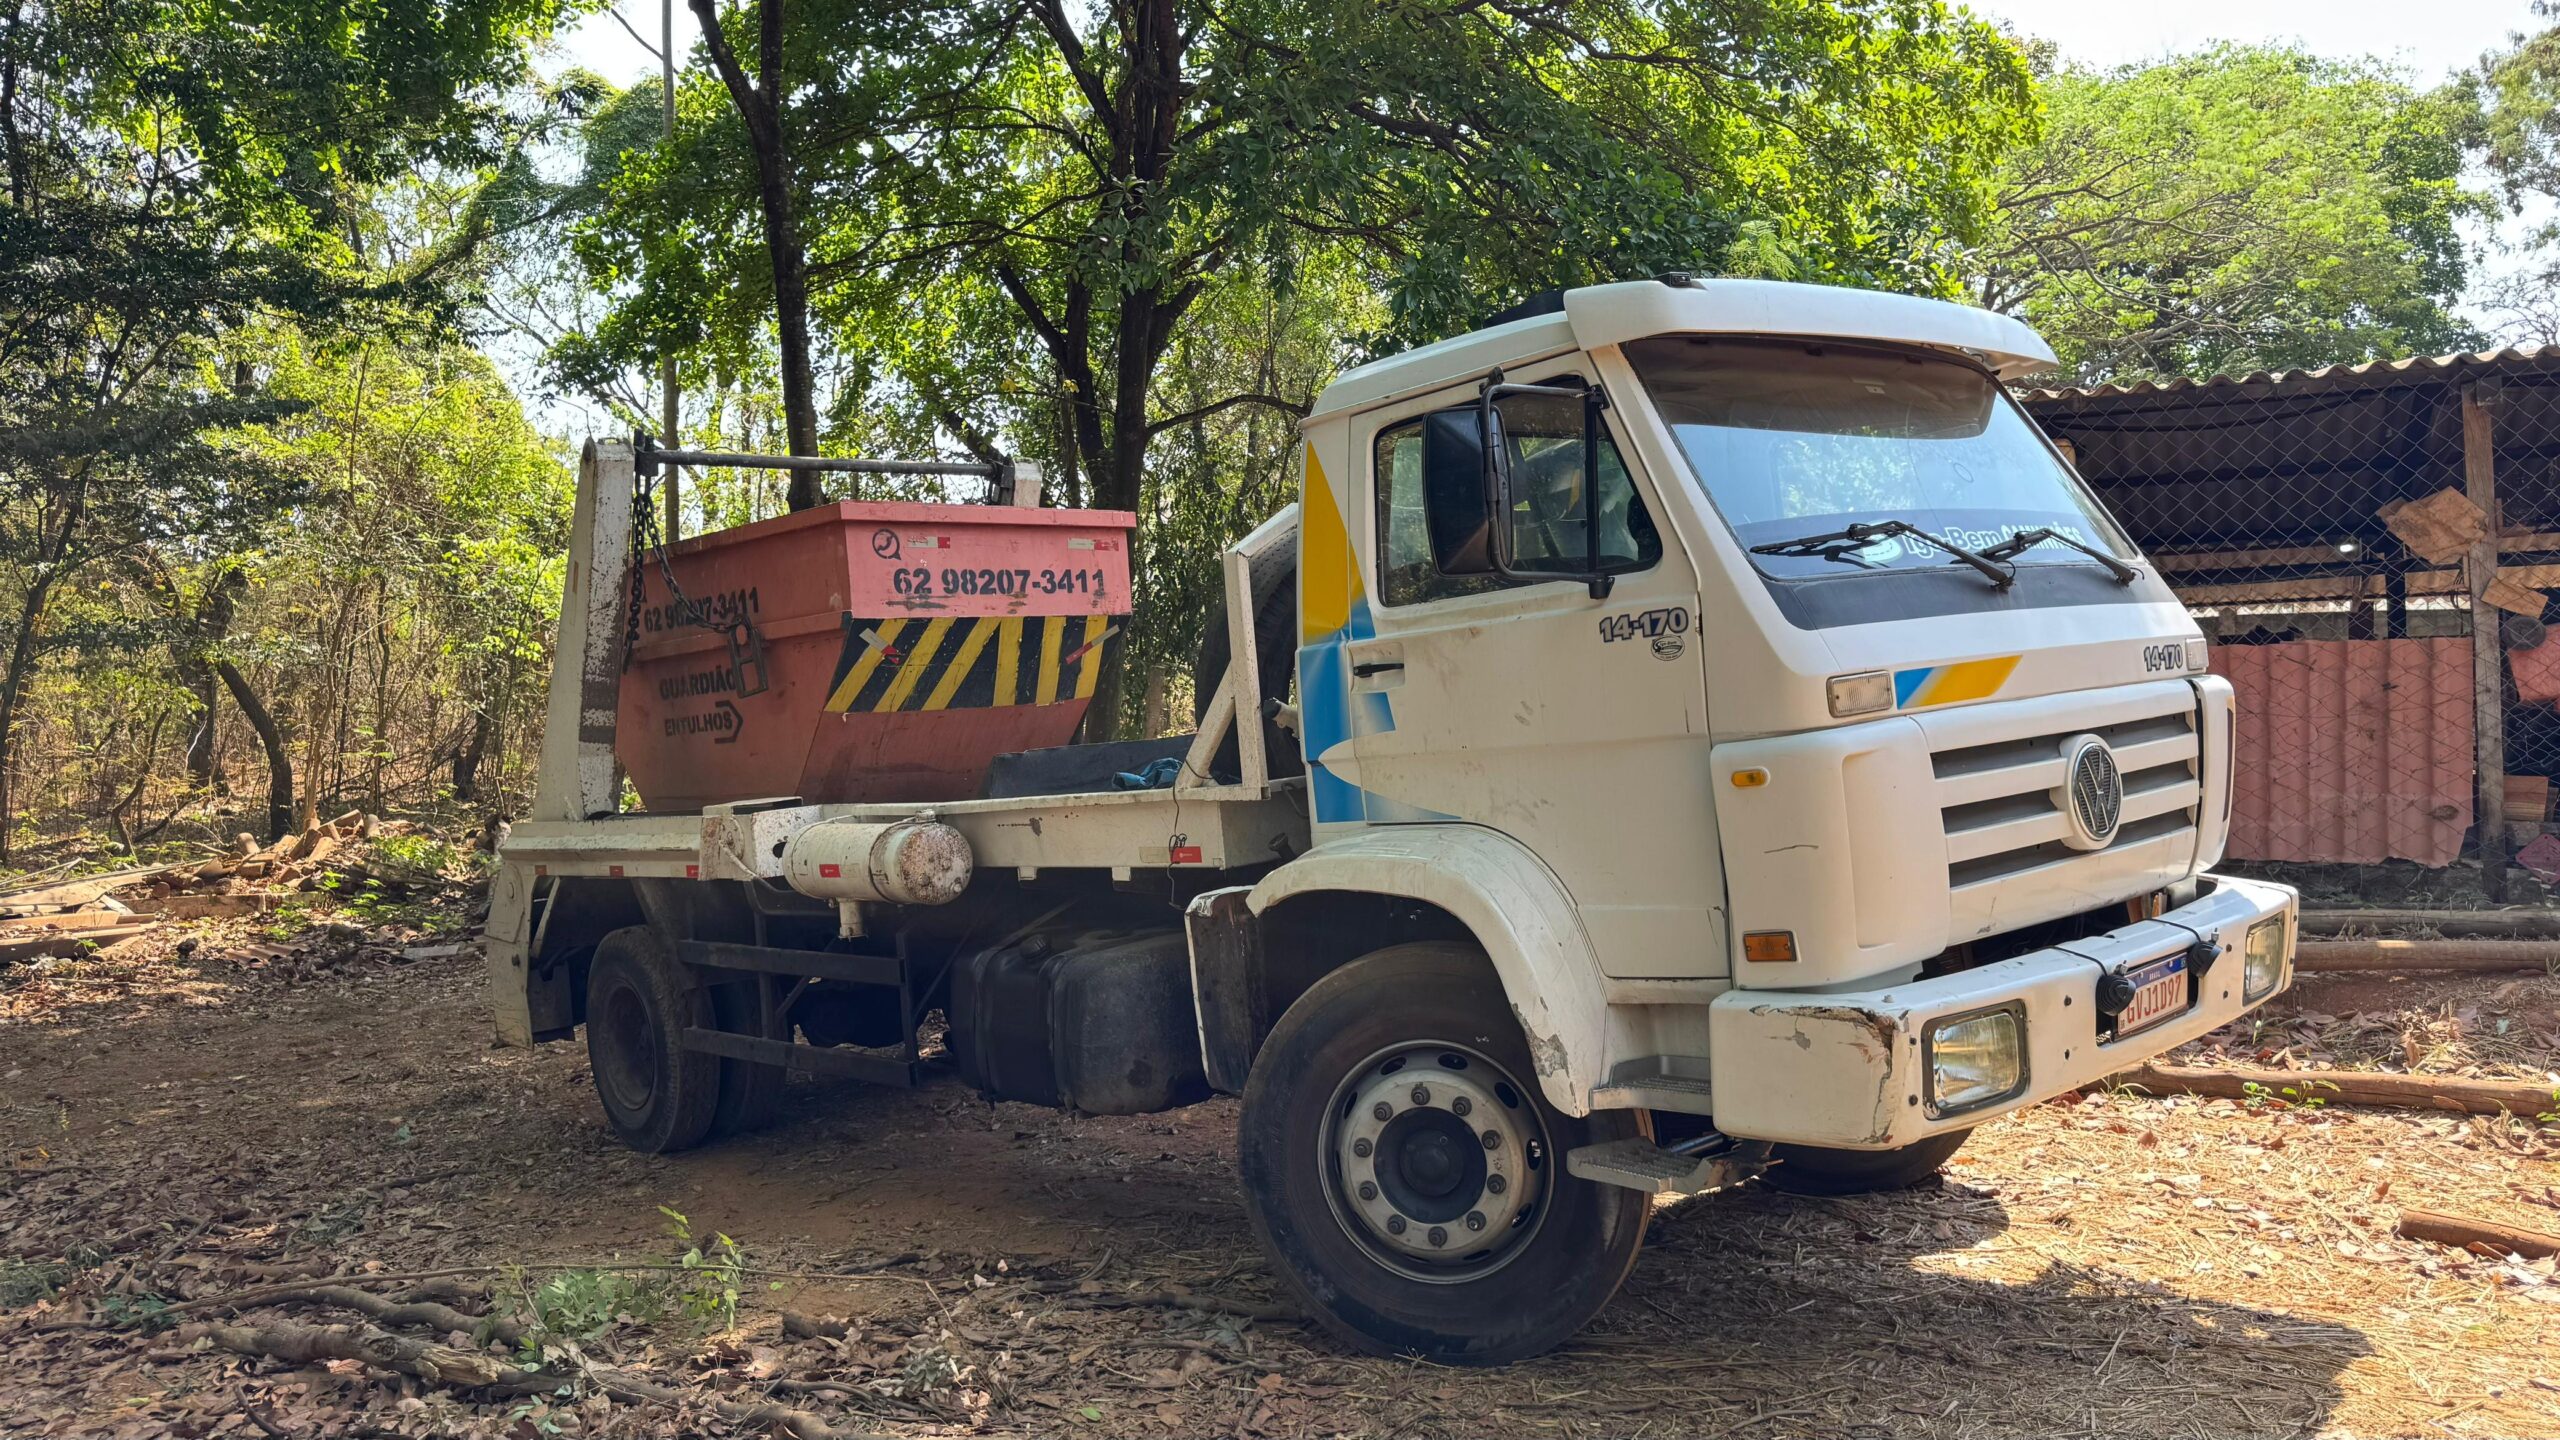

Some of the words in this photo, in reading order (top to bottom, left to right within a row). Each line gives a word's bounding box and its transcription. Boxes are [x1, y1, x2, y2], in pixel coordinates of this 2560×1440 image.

[893, 568, 932, 594] 62
[941, 568, 1104, 595] 98207-3411
[644, 607, 662, 632] 62
[1599, 606, 1689, 643] 14-170
[2144, 643, 2184, 672] 14-170
[665, 710, 733, 737] ENTULHOS
